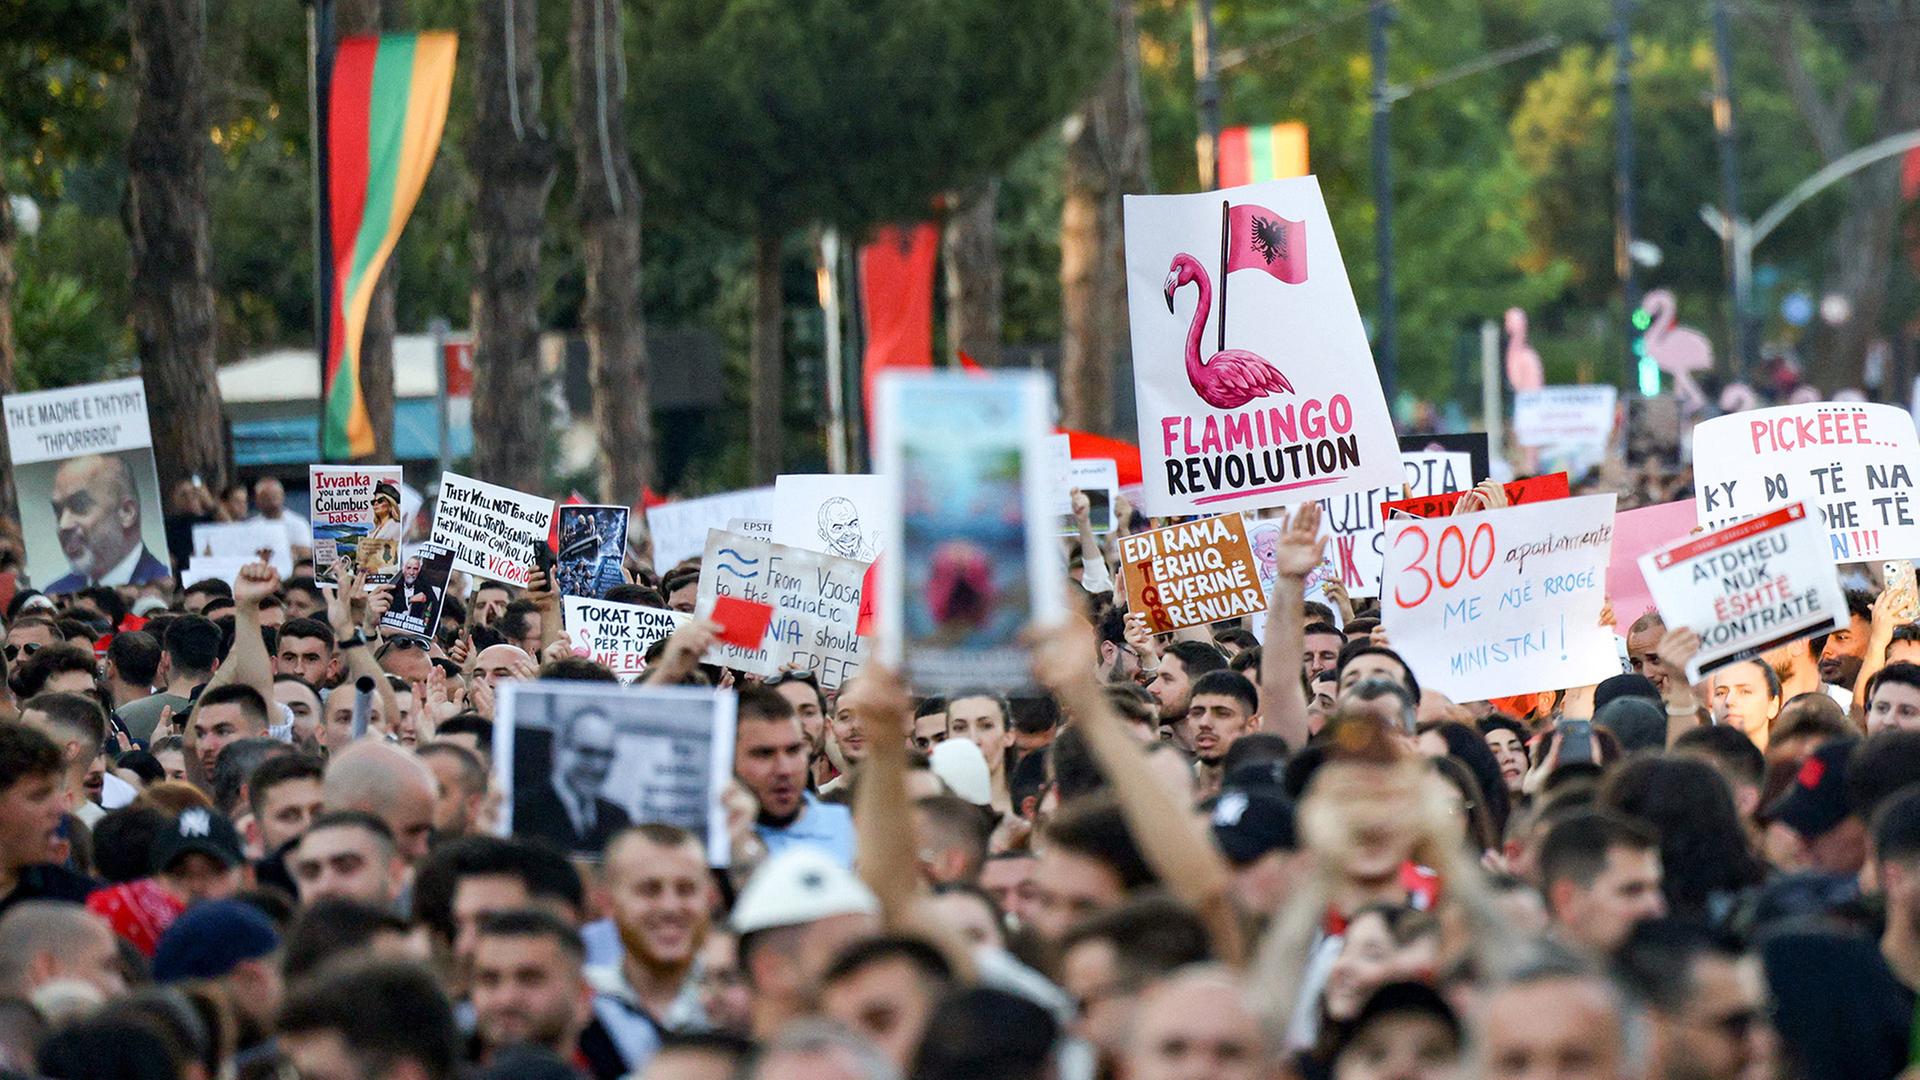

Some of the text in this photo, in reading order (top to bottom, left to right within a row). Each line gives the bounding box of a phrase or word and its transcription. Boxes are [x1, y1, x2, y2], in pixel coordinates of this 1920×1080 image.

[38, 399, 82, 425] MADHE
[1161, 393, 1353, 457] FLAMINGO
[315, 472, 370, 489] Ivvanka
[1164, 433, 1361, 496] REVOLUTION
[316, 497, 369, 512] Columbus
[319, 486, 368, 499] you are not
[1704, 461, 1913, 512] KY DO TË NA
[329, 512, 359, 524] babes
[445, 482, 470, 503] THEY
[470, 489, 491, 509] WILL
[492, 499, 512, 515] NOT
[535, 511, 549, 528] US
[1872, 491, 1915, 526] TË
[441, 500, 536, 547] THEY WILL STOP DEGRADIN
[1124, 518, 1239, 564] EDI RAMA,
[437, 517, 537, 567] THEY WILL NOT CONTROL US
[1693, 532, 1788, 586] ATDHEU
[474, 550, 486, 569] BE
[488, 554, 530, 583] VICTORIO
[1393, 522, 1496, 609] 300
[1721, 563, 1772, 595] NUK
[577, 605, 676, 628] TOKAT TONA
[716, 576, 842, 623] to the adriatic
[1443, 596, 1482, 630] ME
[1499, 579, 1533, 611] NJË
[594, 637, 618, 650] PËR
[599, 623, 631, 638] NUK
[764, 617, 858, 654] NIA should
[595, 650, 647, 669] NË EK
